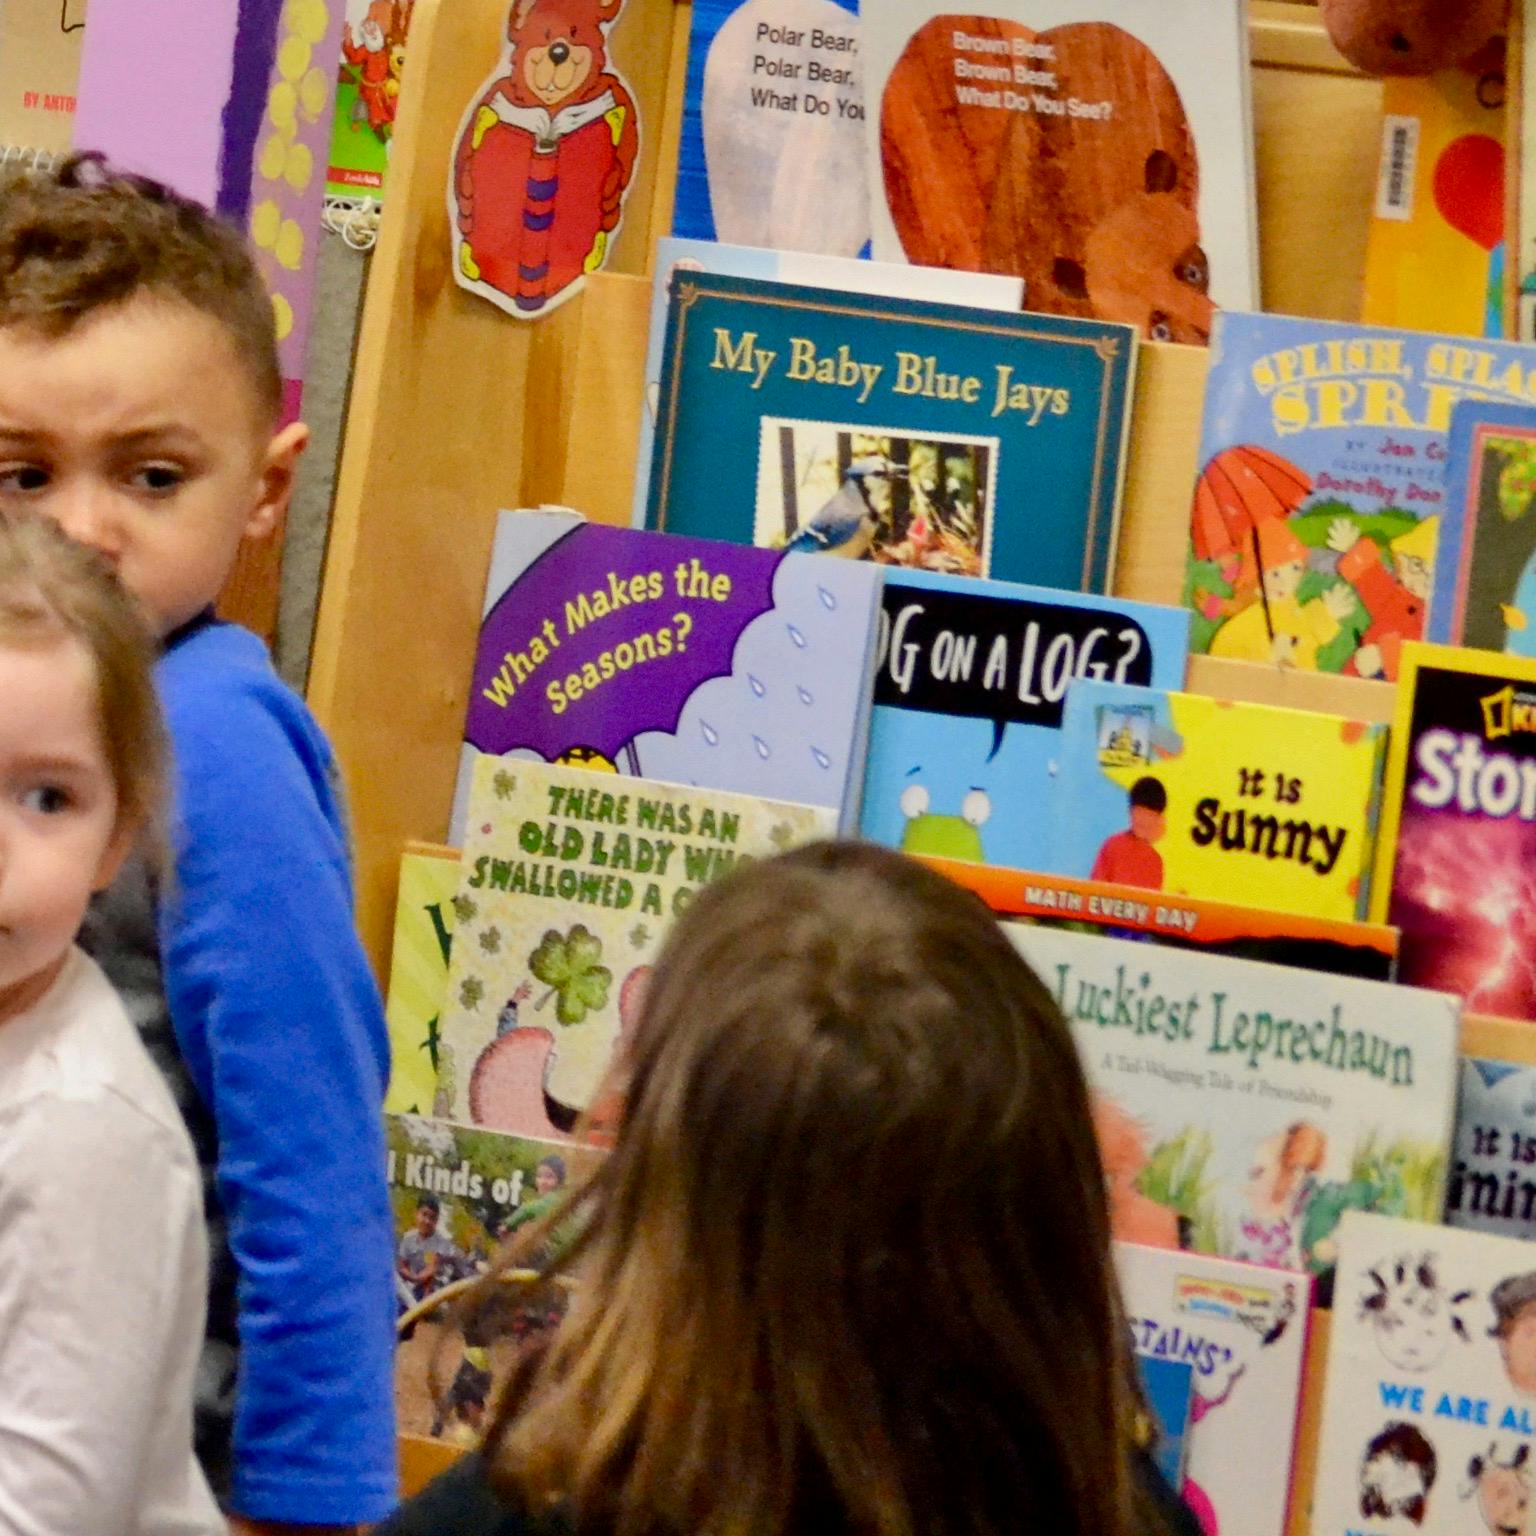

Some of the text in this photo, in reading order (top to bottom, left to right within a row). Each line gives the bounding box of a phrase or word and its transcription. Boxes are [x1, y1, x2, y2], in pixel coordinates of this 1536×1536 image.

[756, 23, 859, 56] Polar Bear,
[953, 31, 1058, 61] Brown Bear,
[754, 57, 856, 88] Polar Bear,
[955, 58, 1059, 90] Brown Bear,
[23, 91, 39, 107] BY
[750, 87, 799, 112] What
[804, 94, 830, 117] Do
[955, 85, 1113, 121] What Do You See?
[710, 327, 1070, 427] My Baby Blue Jays
[1378, 436, 1415, 459] Jan
[1316, 471, 1398, 507] Dorothy
[483, 558, 732, 709] What Makes the
[931, 620, 1141, 706] ON A LOG?
[548, 785, 740, 844] THERE WAS AN
[1189, 797, 1347, 875] Sunny
[518, 820, 675, 876] OLD LADY
[468, 855, 634, 910] SWALLOWED
[640, 883, 662, 915] A
[1025, 886, 1199, 933] MATH EVERY DAY
[1053, 963, 1415, 1087] Luckiest Leprechaun
[1239, 1074, 1255, 1093] of
[405, 1153, 484, 1199] Kinds
[491, 1169, 525, 1207] of
[1379, 1380, 1425, 1413] WE
[1434, 1392, 1490, 1426] ARE
